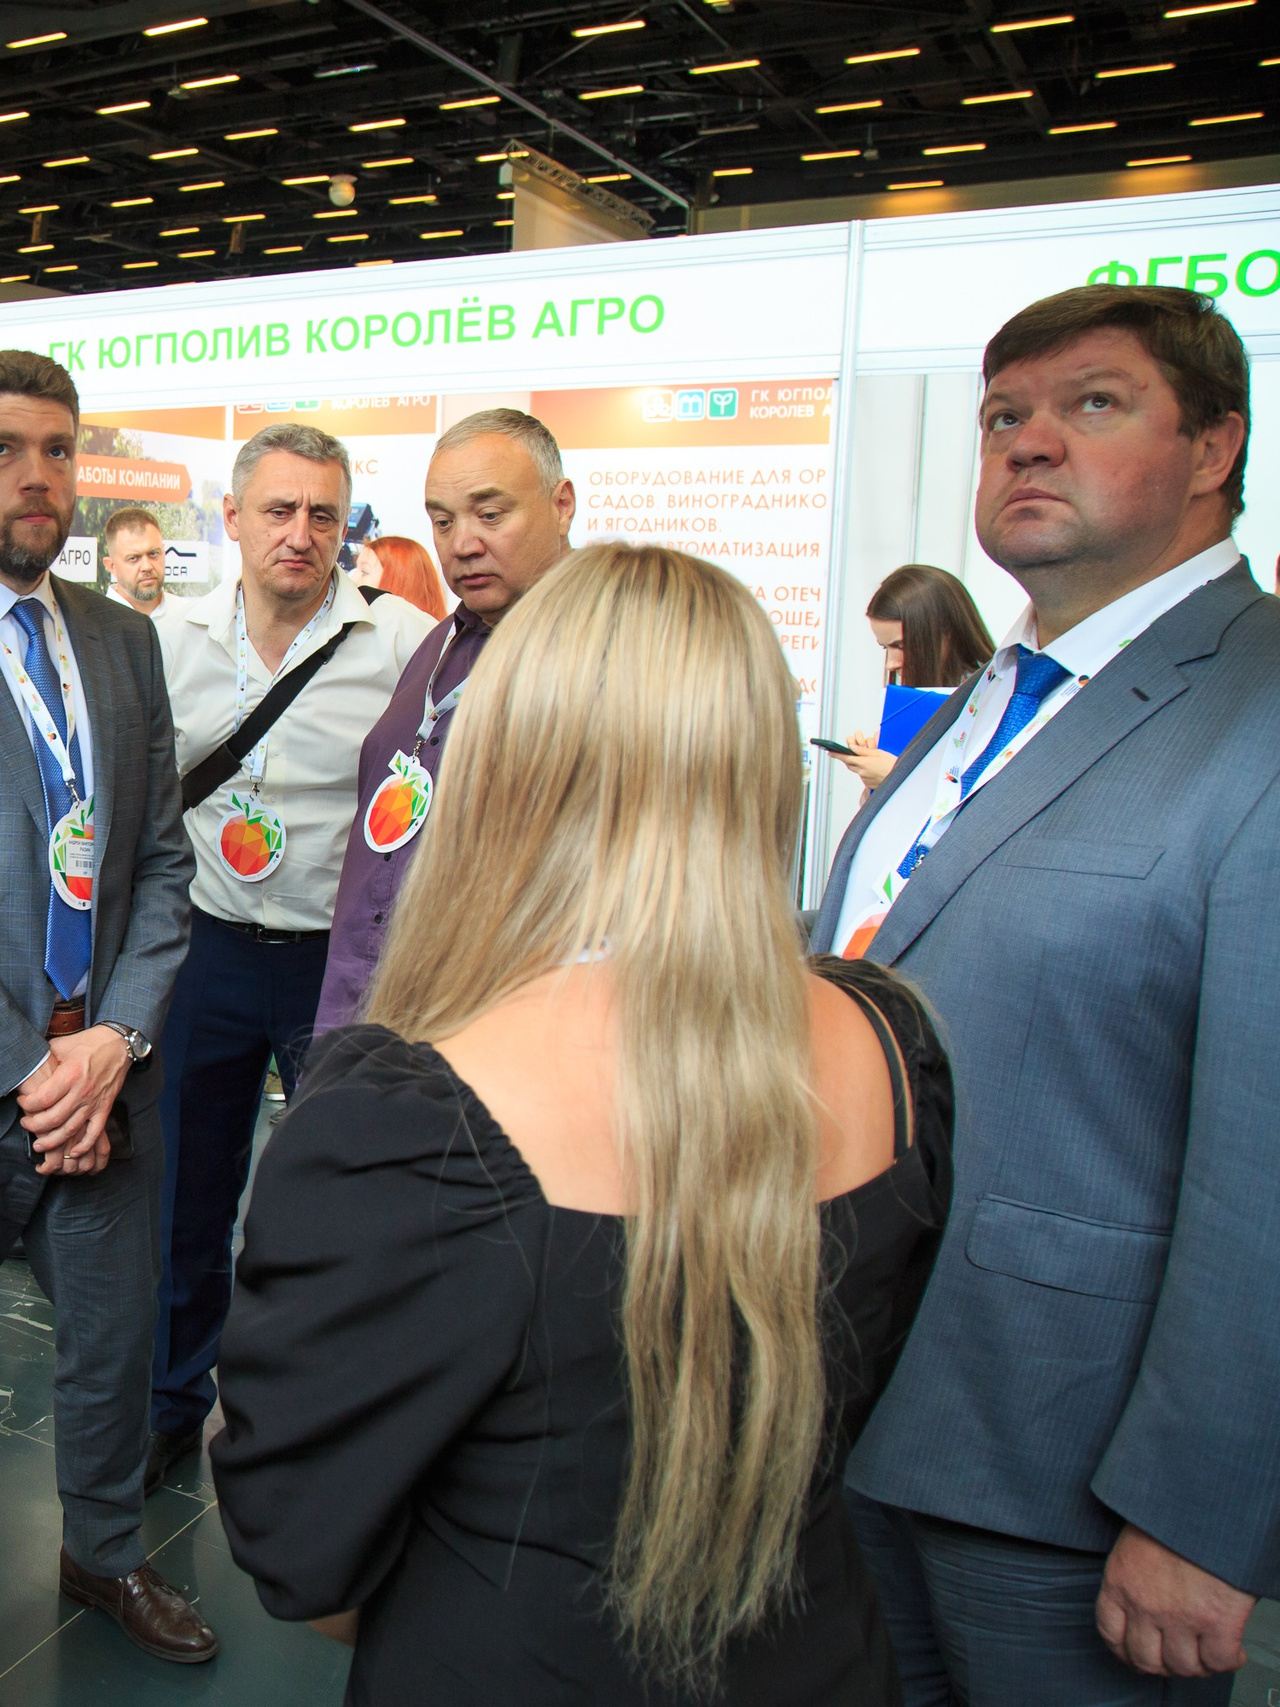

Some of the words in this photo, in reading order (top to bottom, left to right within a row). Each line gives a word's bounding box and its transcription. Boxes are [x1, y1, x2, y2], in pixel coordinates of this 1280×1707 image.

[1086, 250, 1280, 298] ФГБО
[48, 339, 86, 371] ГК
[98, 322, 291, 370] ЮГПОЛИВ
[305, 297, 517, 355] КОРОЛЁВ
[531, 294, 665, 339] АГРО
[397, 395, 430, 407] АГРО
[751, 390, 769, 402] ГК
[750, 405, 815, 419] КОРОЛЕВ
[78, 466, 116, 485] АБОТЫ
[119, 470, 181, 490] КОМПАНИИ
[589, 470, 745, 486] ОБОРУДОВАНИЕ
[750, 469, 791, 486] ДЛЯ
[799, 469, 826, 484] ОР
[668, 493, 827, 510] ВИНОГРАДНИКО
[587, 518, 598, 531] И
[605, 517, 722, 533] ЯГОДНИКОВ.
[59, 549, 91, 566] АГРО
[774, 587, 820, 602] ОТЕЧ
